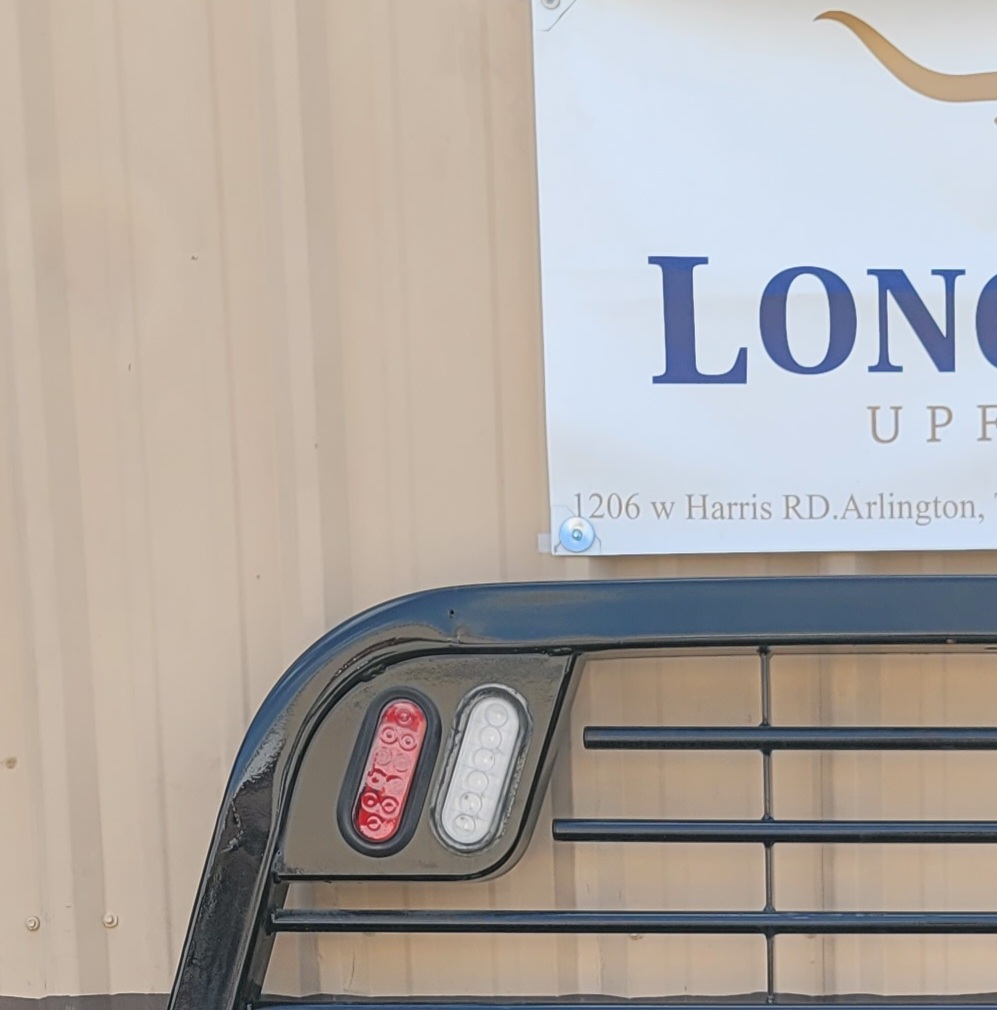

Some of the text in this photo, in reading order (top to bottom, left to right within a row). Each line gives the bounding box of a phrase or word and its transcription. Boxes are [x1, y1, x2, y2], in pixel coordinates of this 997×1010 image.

[573, 492, 641, 519] 1206
[650, 502, 675, 518] w
[685, 494, 773, 520] Harris
